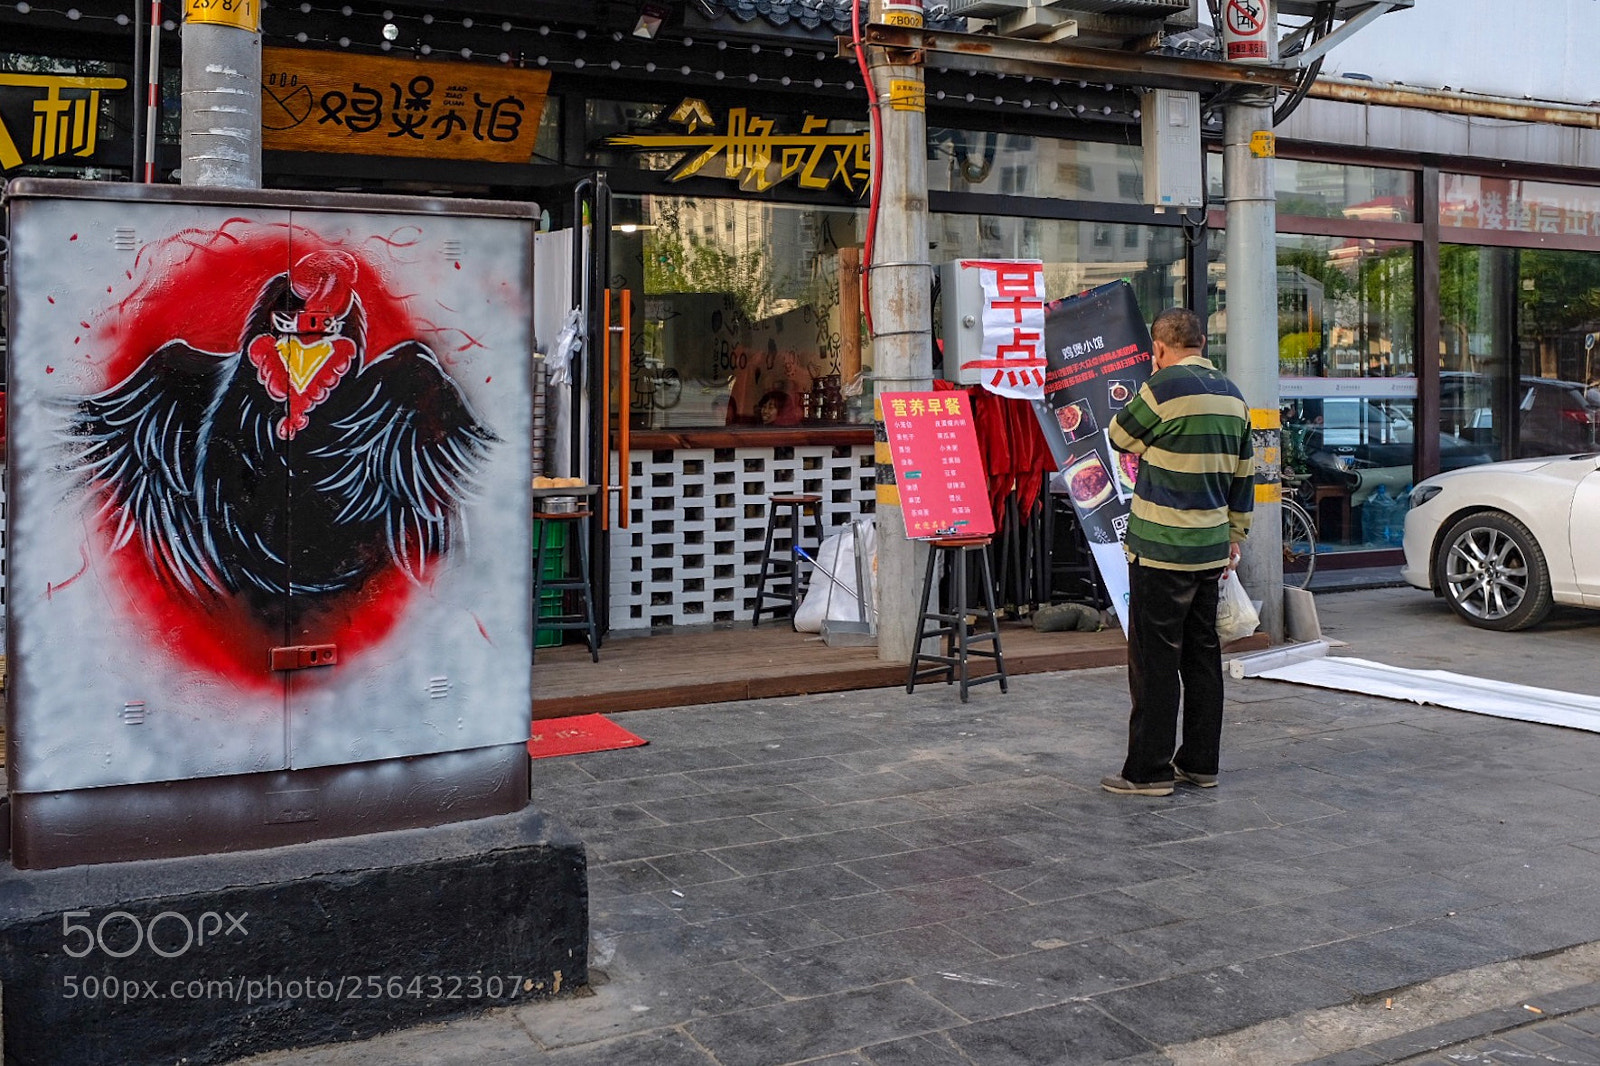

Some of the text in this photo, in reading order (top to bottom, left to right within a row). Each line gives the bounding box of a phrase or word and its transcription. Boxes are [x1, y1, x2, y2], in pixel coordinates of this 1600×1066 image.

[961, 260, 1049, 388] 早点
[890, 397, 962, 417] 营养早餐
